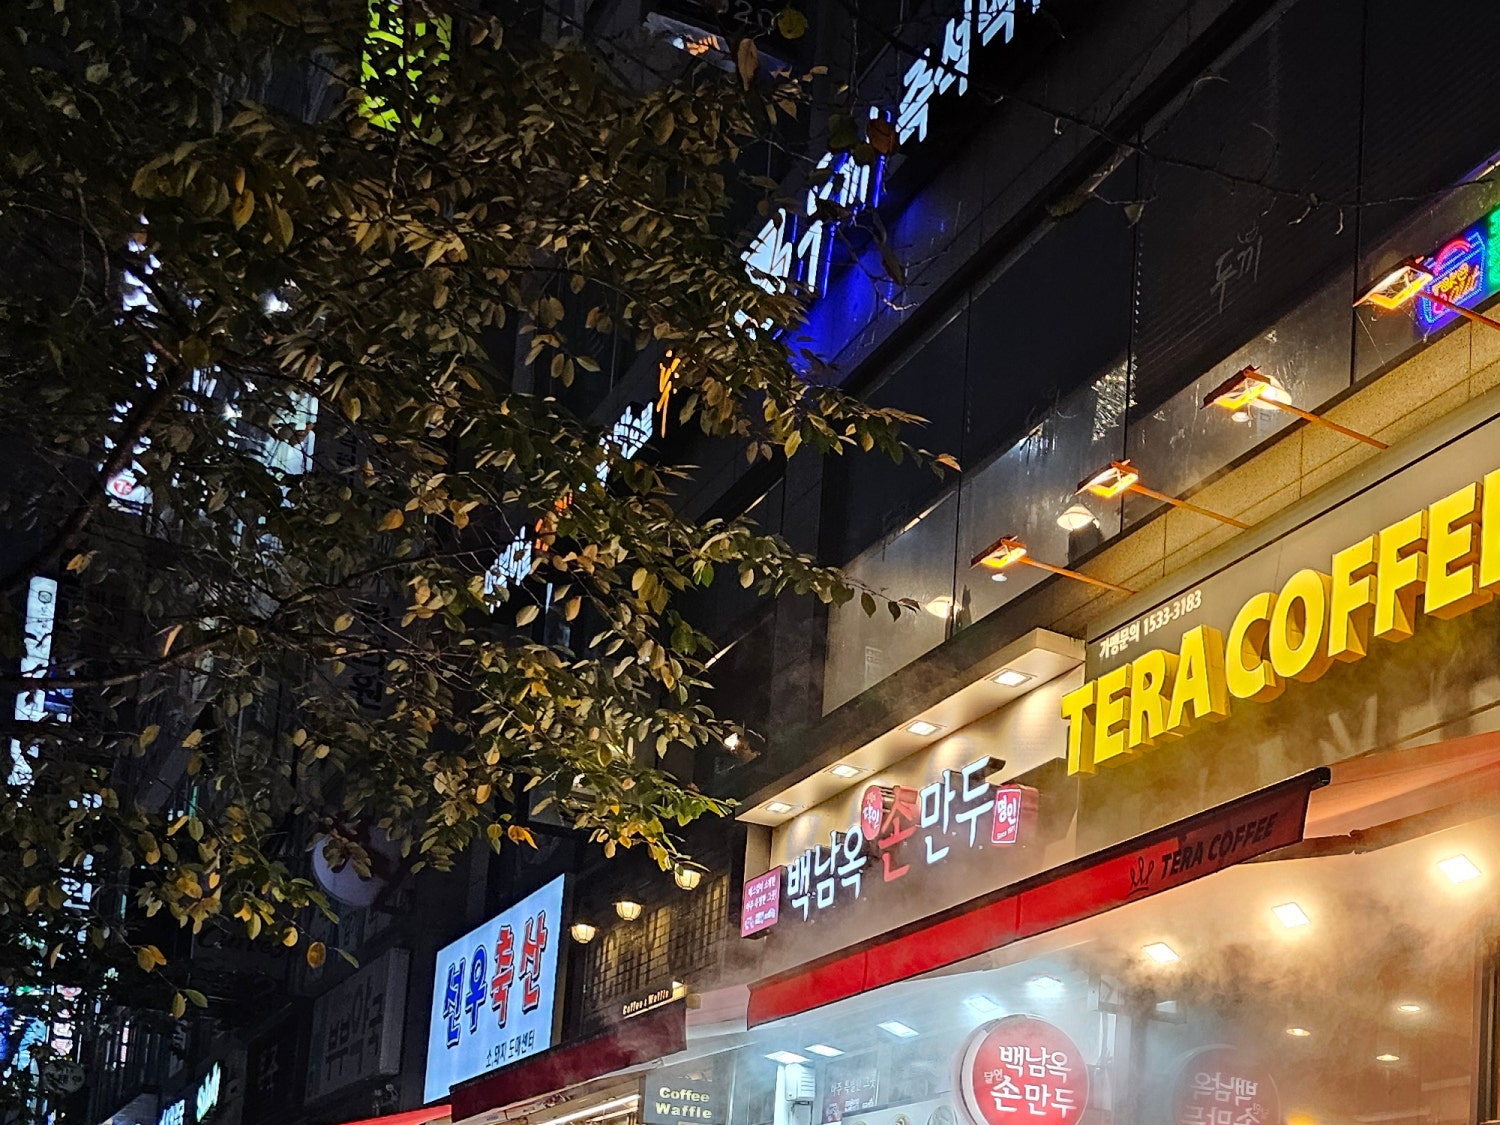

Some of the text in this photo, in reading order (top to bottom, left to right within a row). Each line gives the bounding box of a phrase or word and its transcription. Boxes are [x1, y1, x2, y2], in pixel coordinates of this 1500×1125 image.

[1142, 590, 1203, 638] 1533-3183
[1061, 623, 1231, 776] TERA
[997, 795, 1016, 826] 명인
[1159, 811, 1278, 878] TERA COFFEE
[787, 825, 867, 922] 백남옥
[998, 1044, 1070, 1084] 백남옥
[656, 1103, 712, 1119] Waffle
[660, 1086, 710, 1103] Coffee
[990, 1078, 1077, 1120] 손만두
